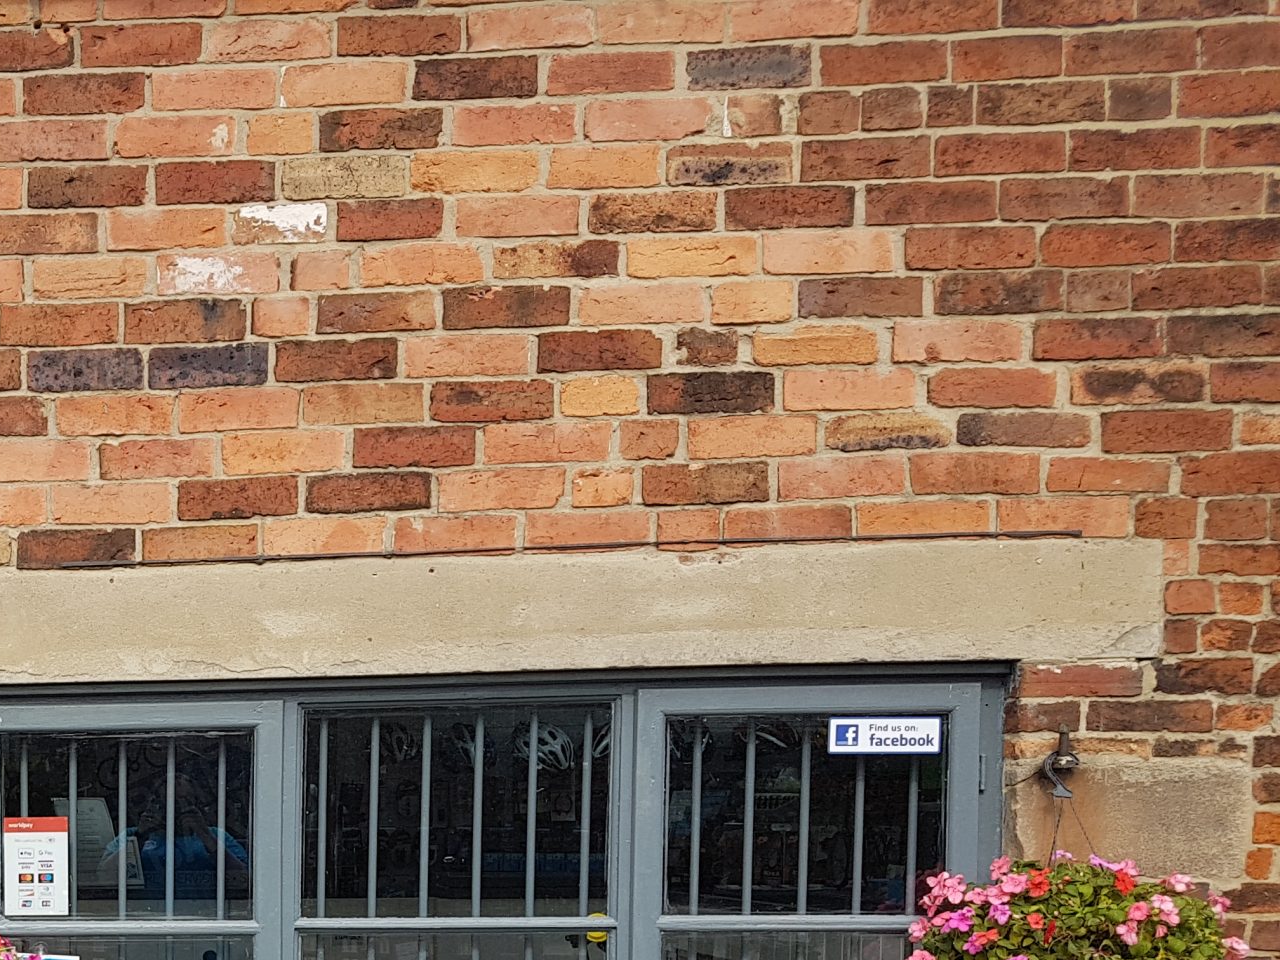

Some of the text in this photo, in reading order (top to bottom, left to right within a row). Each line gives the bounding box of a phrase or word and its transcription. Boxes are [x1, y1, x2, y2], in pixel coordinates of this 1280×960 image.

[869, 724, 888, 732] Find
[904, 724, 919, 732] on:
[869, 734, 934, 747] facebook
